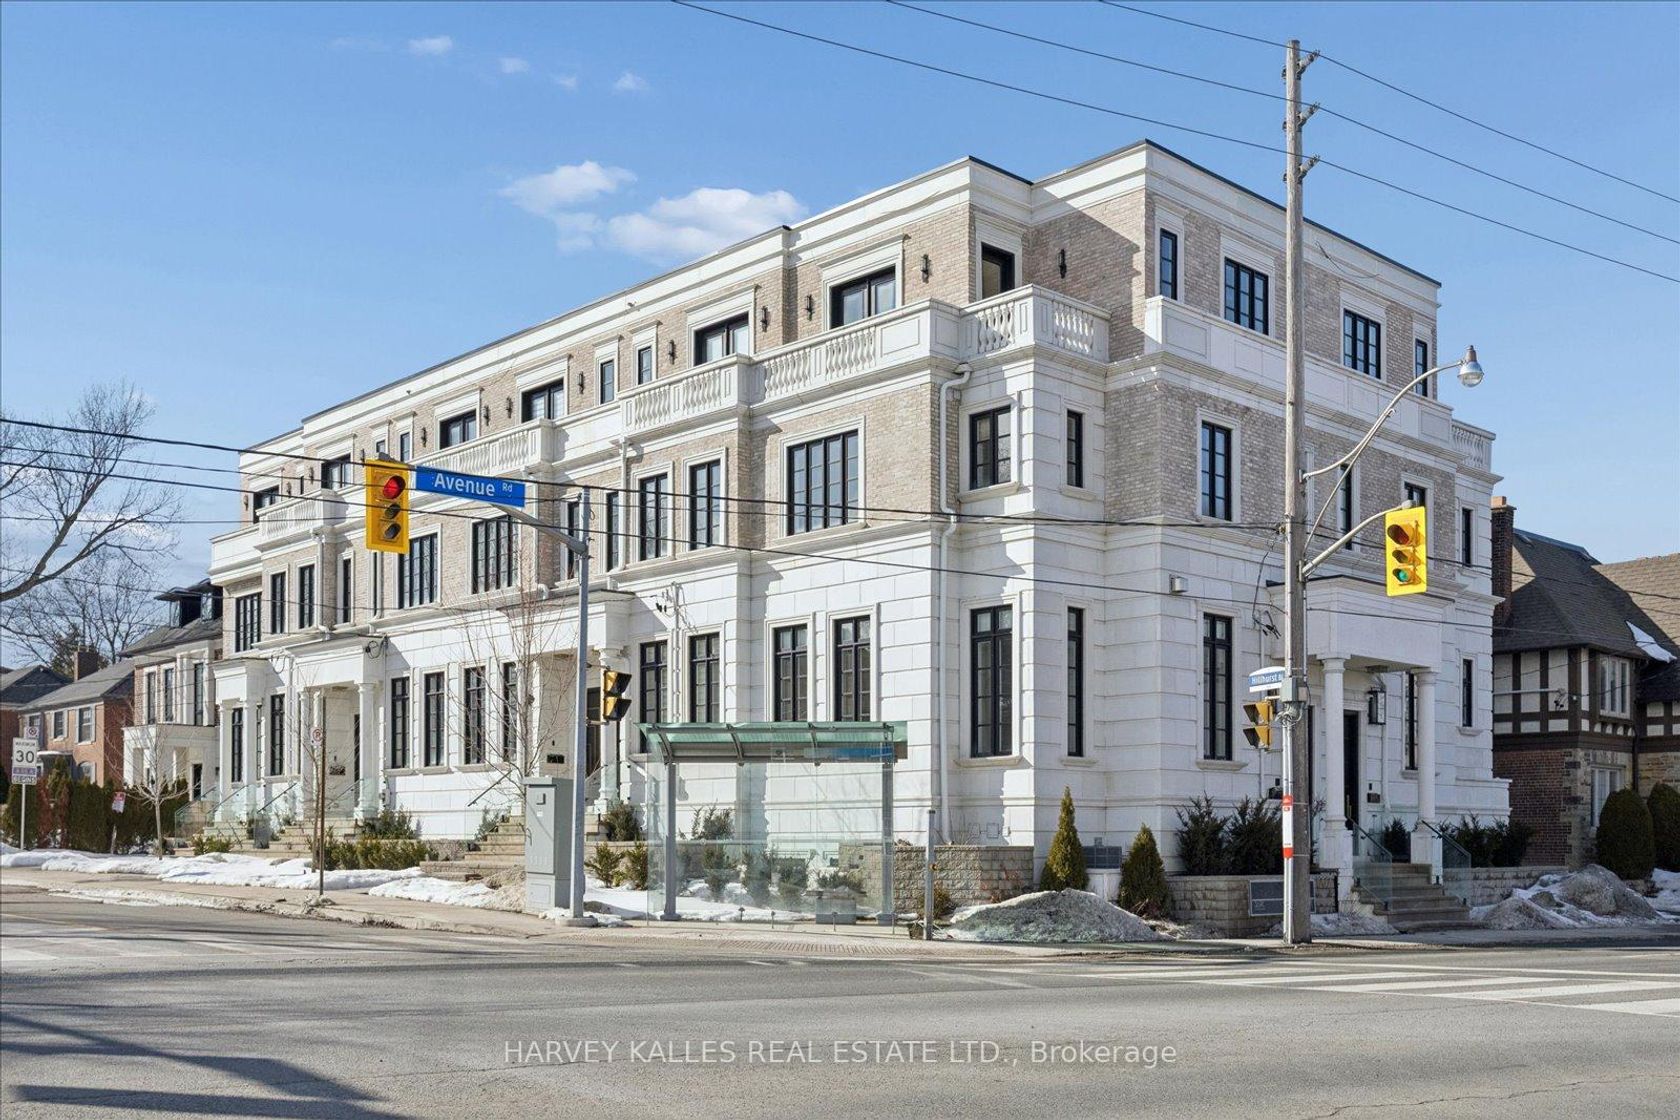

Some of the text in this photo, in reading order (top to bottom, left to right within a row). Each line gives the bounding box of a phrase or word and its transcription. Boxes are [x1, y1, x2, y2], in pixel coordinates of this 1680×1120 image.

[434, 473, 513, 496] Avenue Rd
[15, 750, 35, 763] 30
